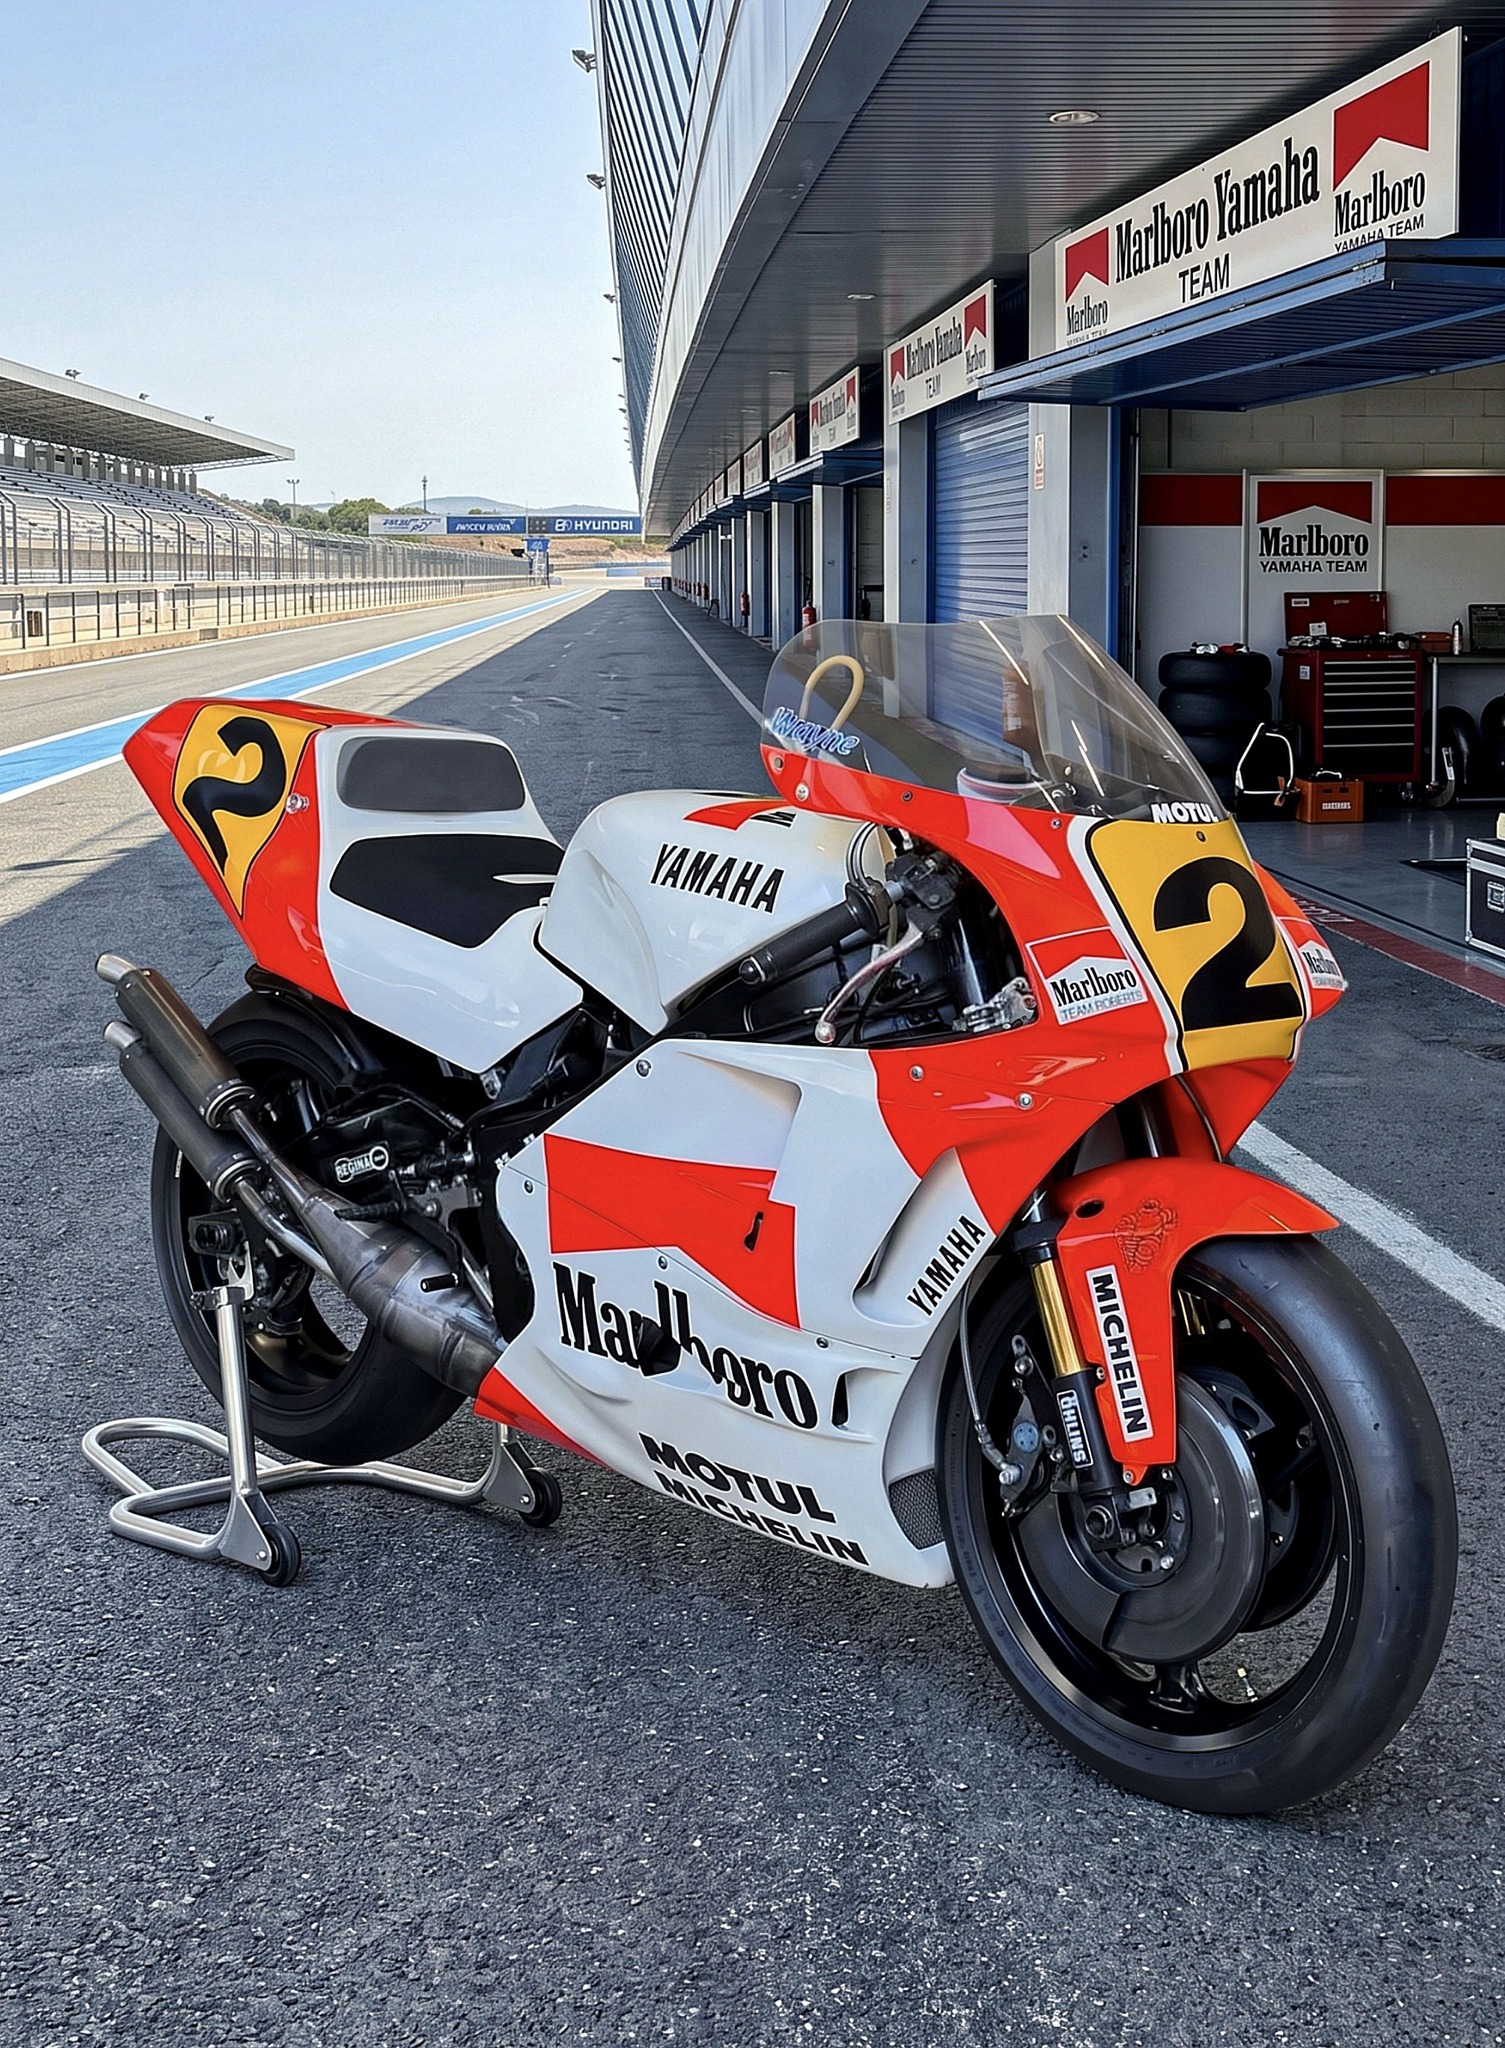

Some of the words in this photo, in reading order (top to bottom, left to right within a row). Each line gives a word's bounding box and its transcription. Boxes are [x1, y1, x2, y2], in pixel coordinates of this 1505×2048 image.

[1115, 201, 1210, 284] Marlboro
[1214, 137, 1320, 242] Yamaha
[1333, 169, 1426, 238] Marlboro
[1387, 213, 1424, 238] TEAM
[1178, 253, 1230, 304] TEAM
[574, 520, 633, 531] HYUNDAI
[1258, 524, 1369, 557] Marlboro
[1259, 560, 1323, 573] YAMAHA
[1325, 560, 1368, 573] TEAM
[771, 706, 861, 756] Wayne
[182, 716, 287, 874] 2
[1150, 801, 1220, 824] MOTUL
[650, 843, 785, 914] YAMAHA
[1153, 855, 1303, 1032] 2
[1050, 966, 1138, 1008] Marlboro
[1060, 1003, 1093, 1020] TEAM
[1095, 990, 1143, 1011] ROBERTS
[335, 1155, 373, 1179] REGINA
[907, 1215, 987, 1317] YAMAHA
[1092, 1273, 1148, 1434] MICHELIN
[638, 1431, 837, 1524] MOTUL
[653, 1469, 870, 1567] MICHELIN
